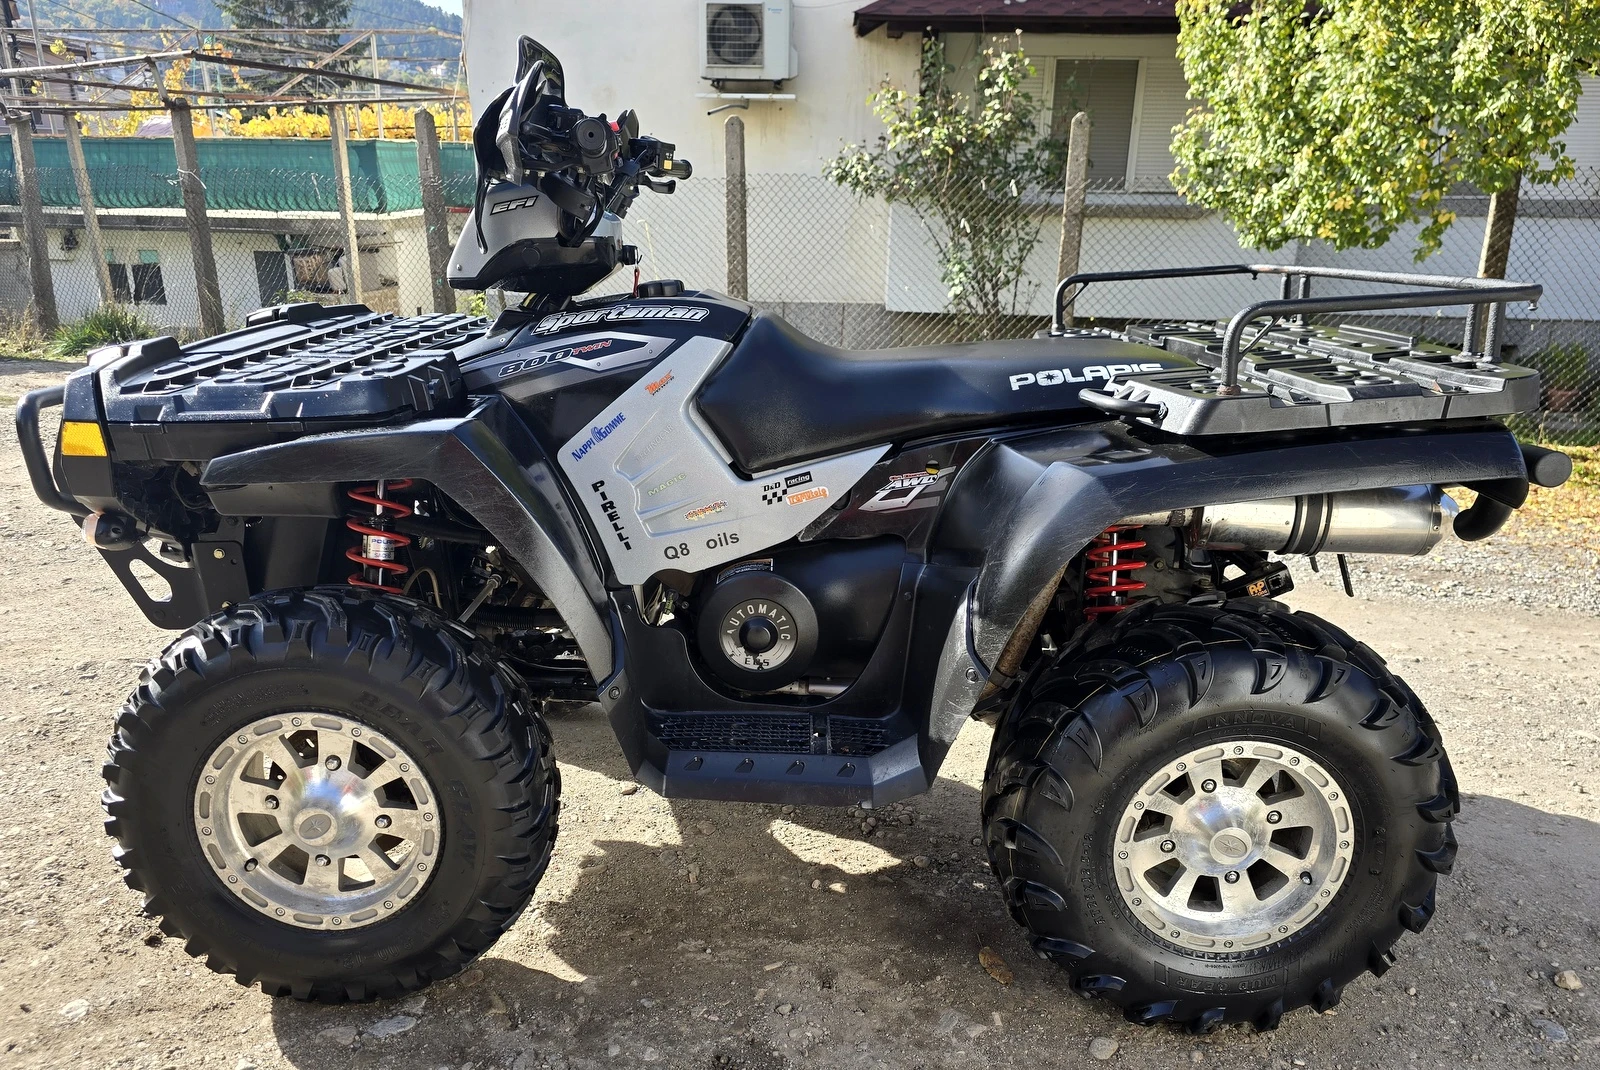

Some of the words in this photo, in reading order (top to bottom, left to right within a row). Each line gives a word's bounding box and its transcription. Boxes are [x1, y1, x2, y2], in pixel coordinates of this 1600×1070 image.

[490, 195, 539, 215] EFI
[531, 304, 710, 335] Sportsman
[498, 348, 573, 377] 800
[572, 339, 613, 356] TWIN
[647, 472, 687, 497] MAGIC
[591, 480, 632, 551] PIRELLI
[663, 543, 690, 560] Q8
[706, 530, 740, 550] oils
[1205, 710, 1296, 729] INNOVA
